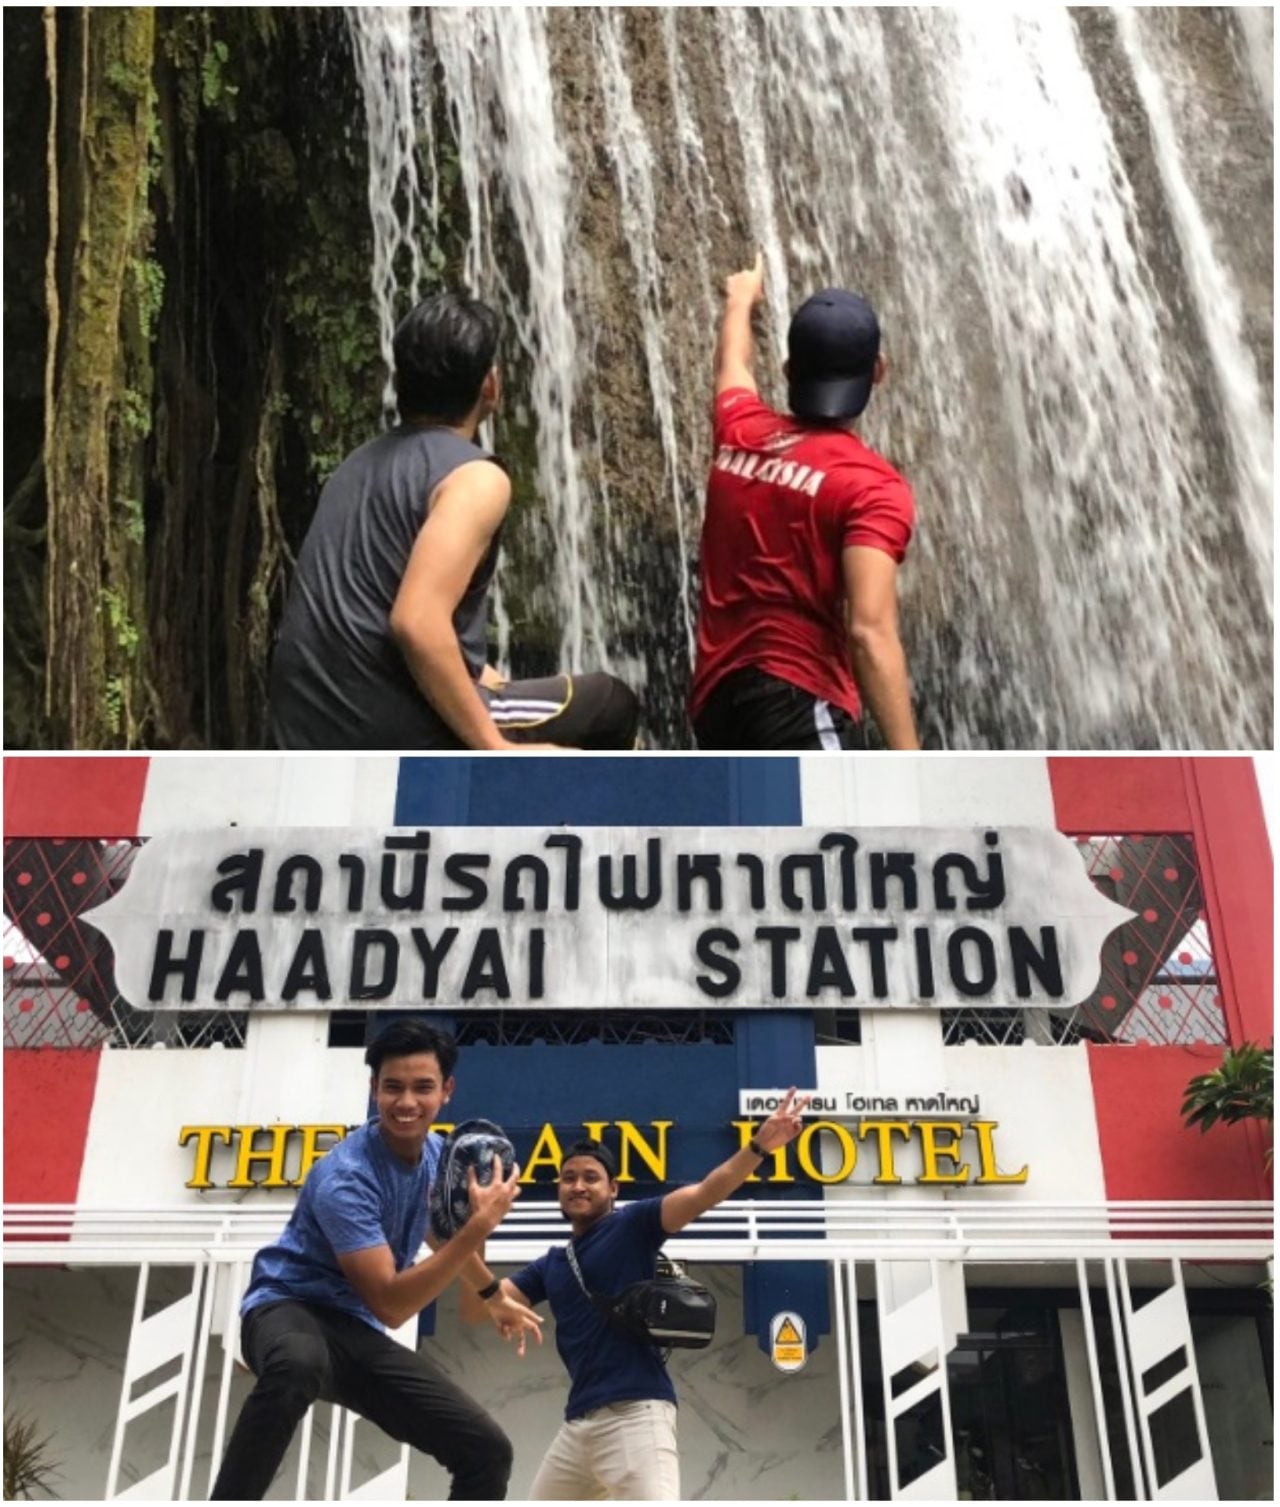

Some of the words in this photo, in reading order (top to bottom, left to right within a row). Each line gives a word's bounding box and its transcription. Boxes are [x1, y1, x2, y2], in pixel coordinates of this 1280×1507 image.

[211, 831, 1006, 912] สถานีรถไฟหาดใหญ่
[148, 927, 545, 1002] HAADYAI
[695, 925, 1064, 999] STATION
